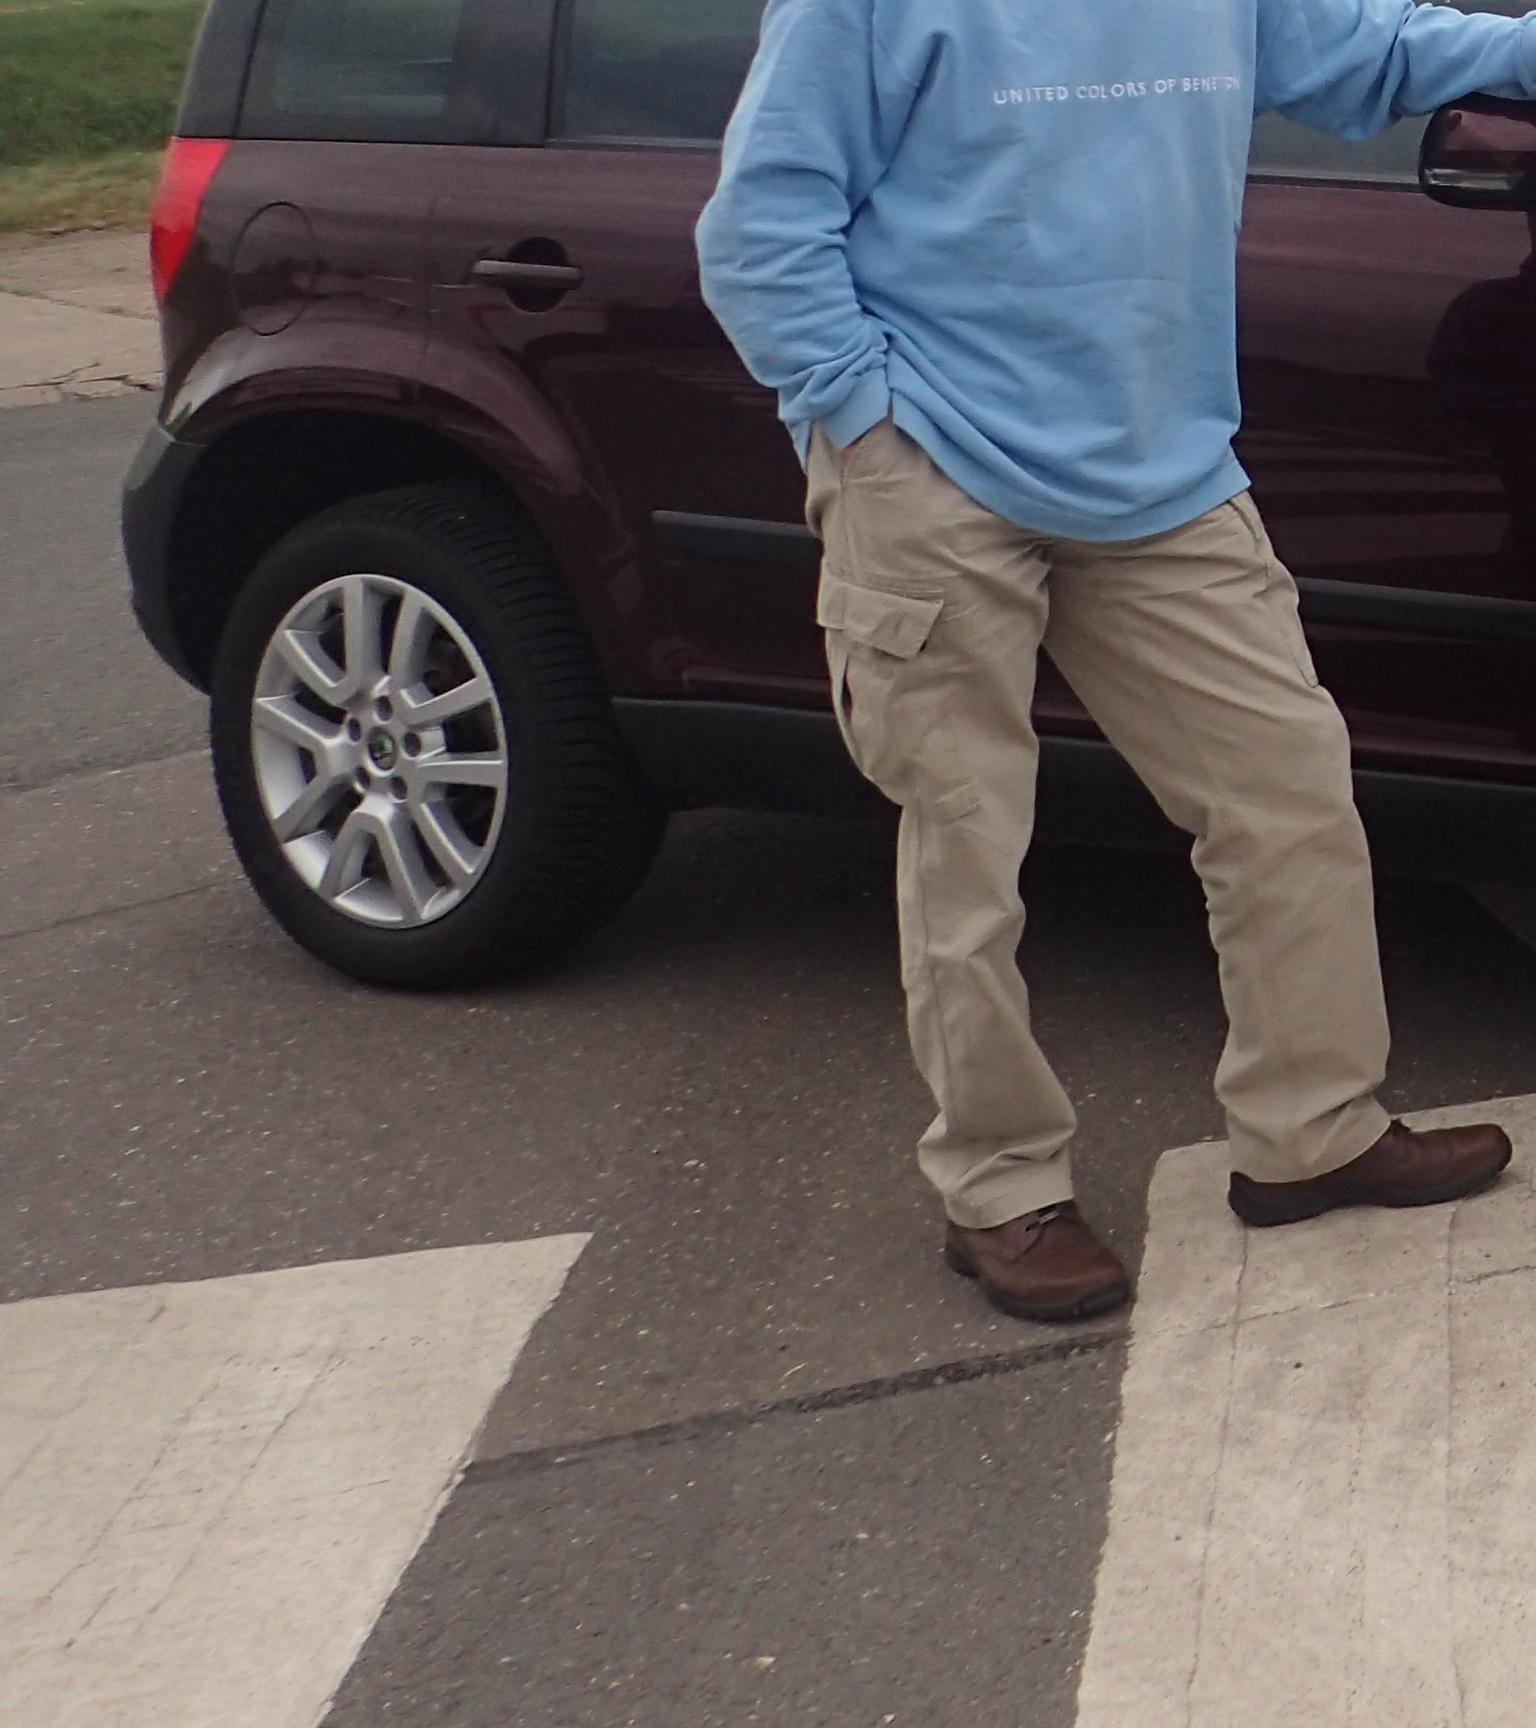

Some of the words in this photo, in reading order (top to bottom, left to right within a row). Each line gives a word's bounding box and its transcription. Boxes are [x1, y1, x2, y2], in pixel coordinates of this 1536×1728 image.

[993, 85, 1069, 106] UNITED
[1076, 81, 1147, 100] COLORS
[1154, 76, 1176, 94] OF
